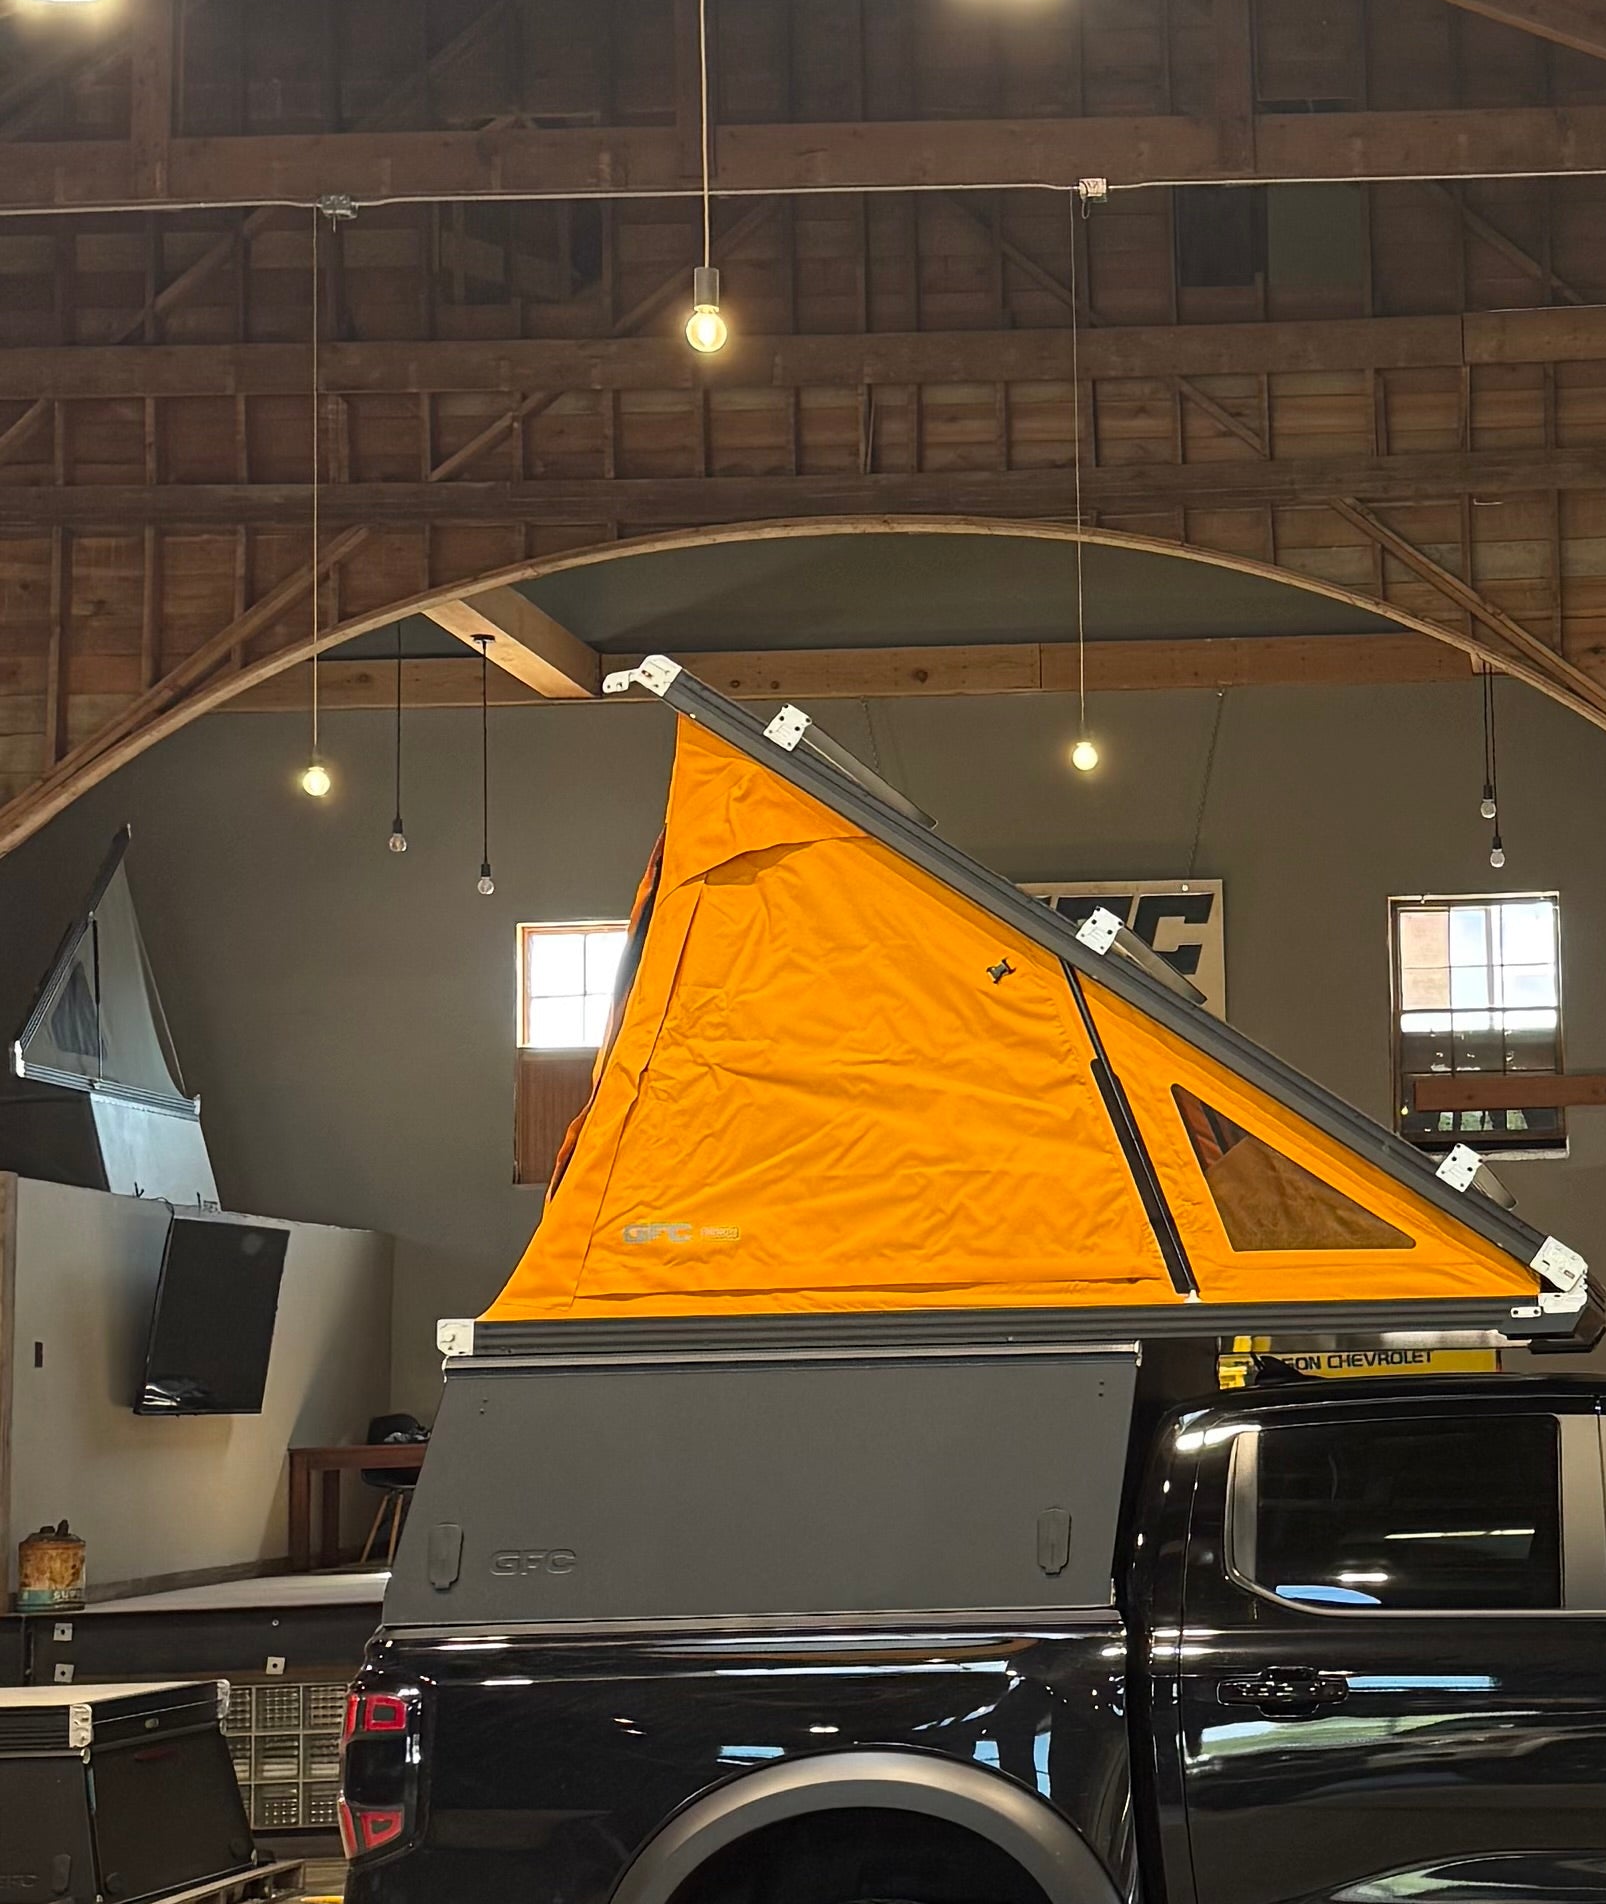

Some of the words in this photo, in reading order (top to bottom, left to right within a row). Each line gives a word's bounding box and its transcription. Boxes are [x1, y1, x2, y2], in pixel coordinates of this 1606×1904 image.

[623, 1222, 692, 1243] GFC
[1327, 1349, 1432, 1368] CHEVROLET
[489, 1548, 577, 1576] GFC
